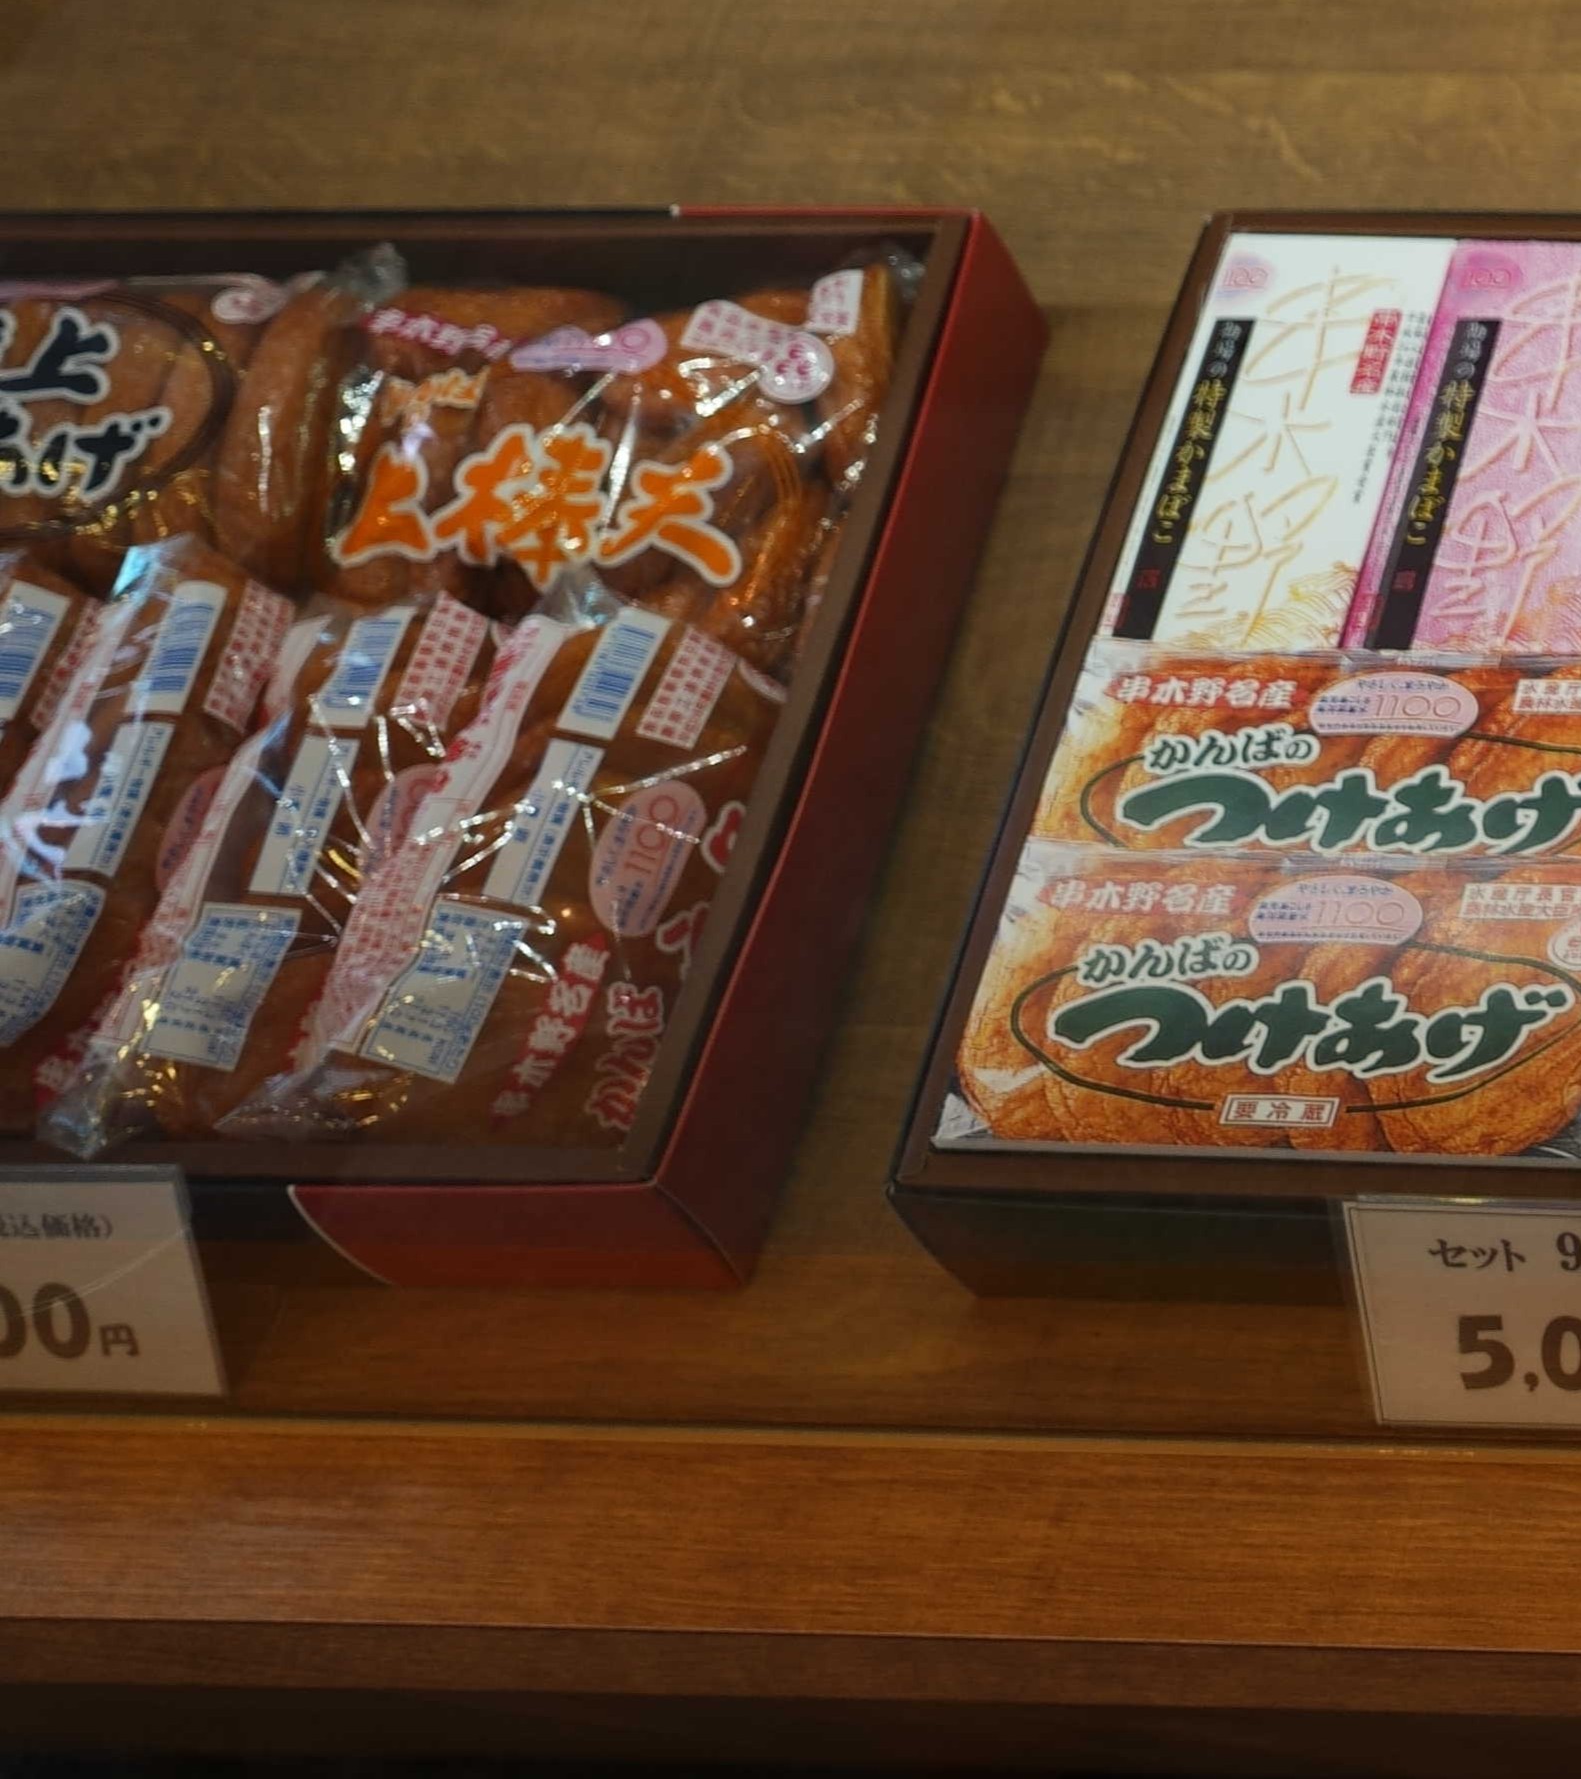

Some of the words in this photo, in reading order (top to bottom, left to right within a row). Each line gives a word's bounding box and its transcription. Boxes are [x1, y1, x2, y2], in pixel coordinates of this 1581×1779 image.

[1148, 732, 1314, 772] かんばの
[1080, 939, 1254, 981] かんばの
[1053, 981, 1568, 1080] つけあげ
[1428, 1237, 1526, 1273] セット
